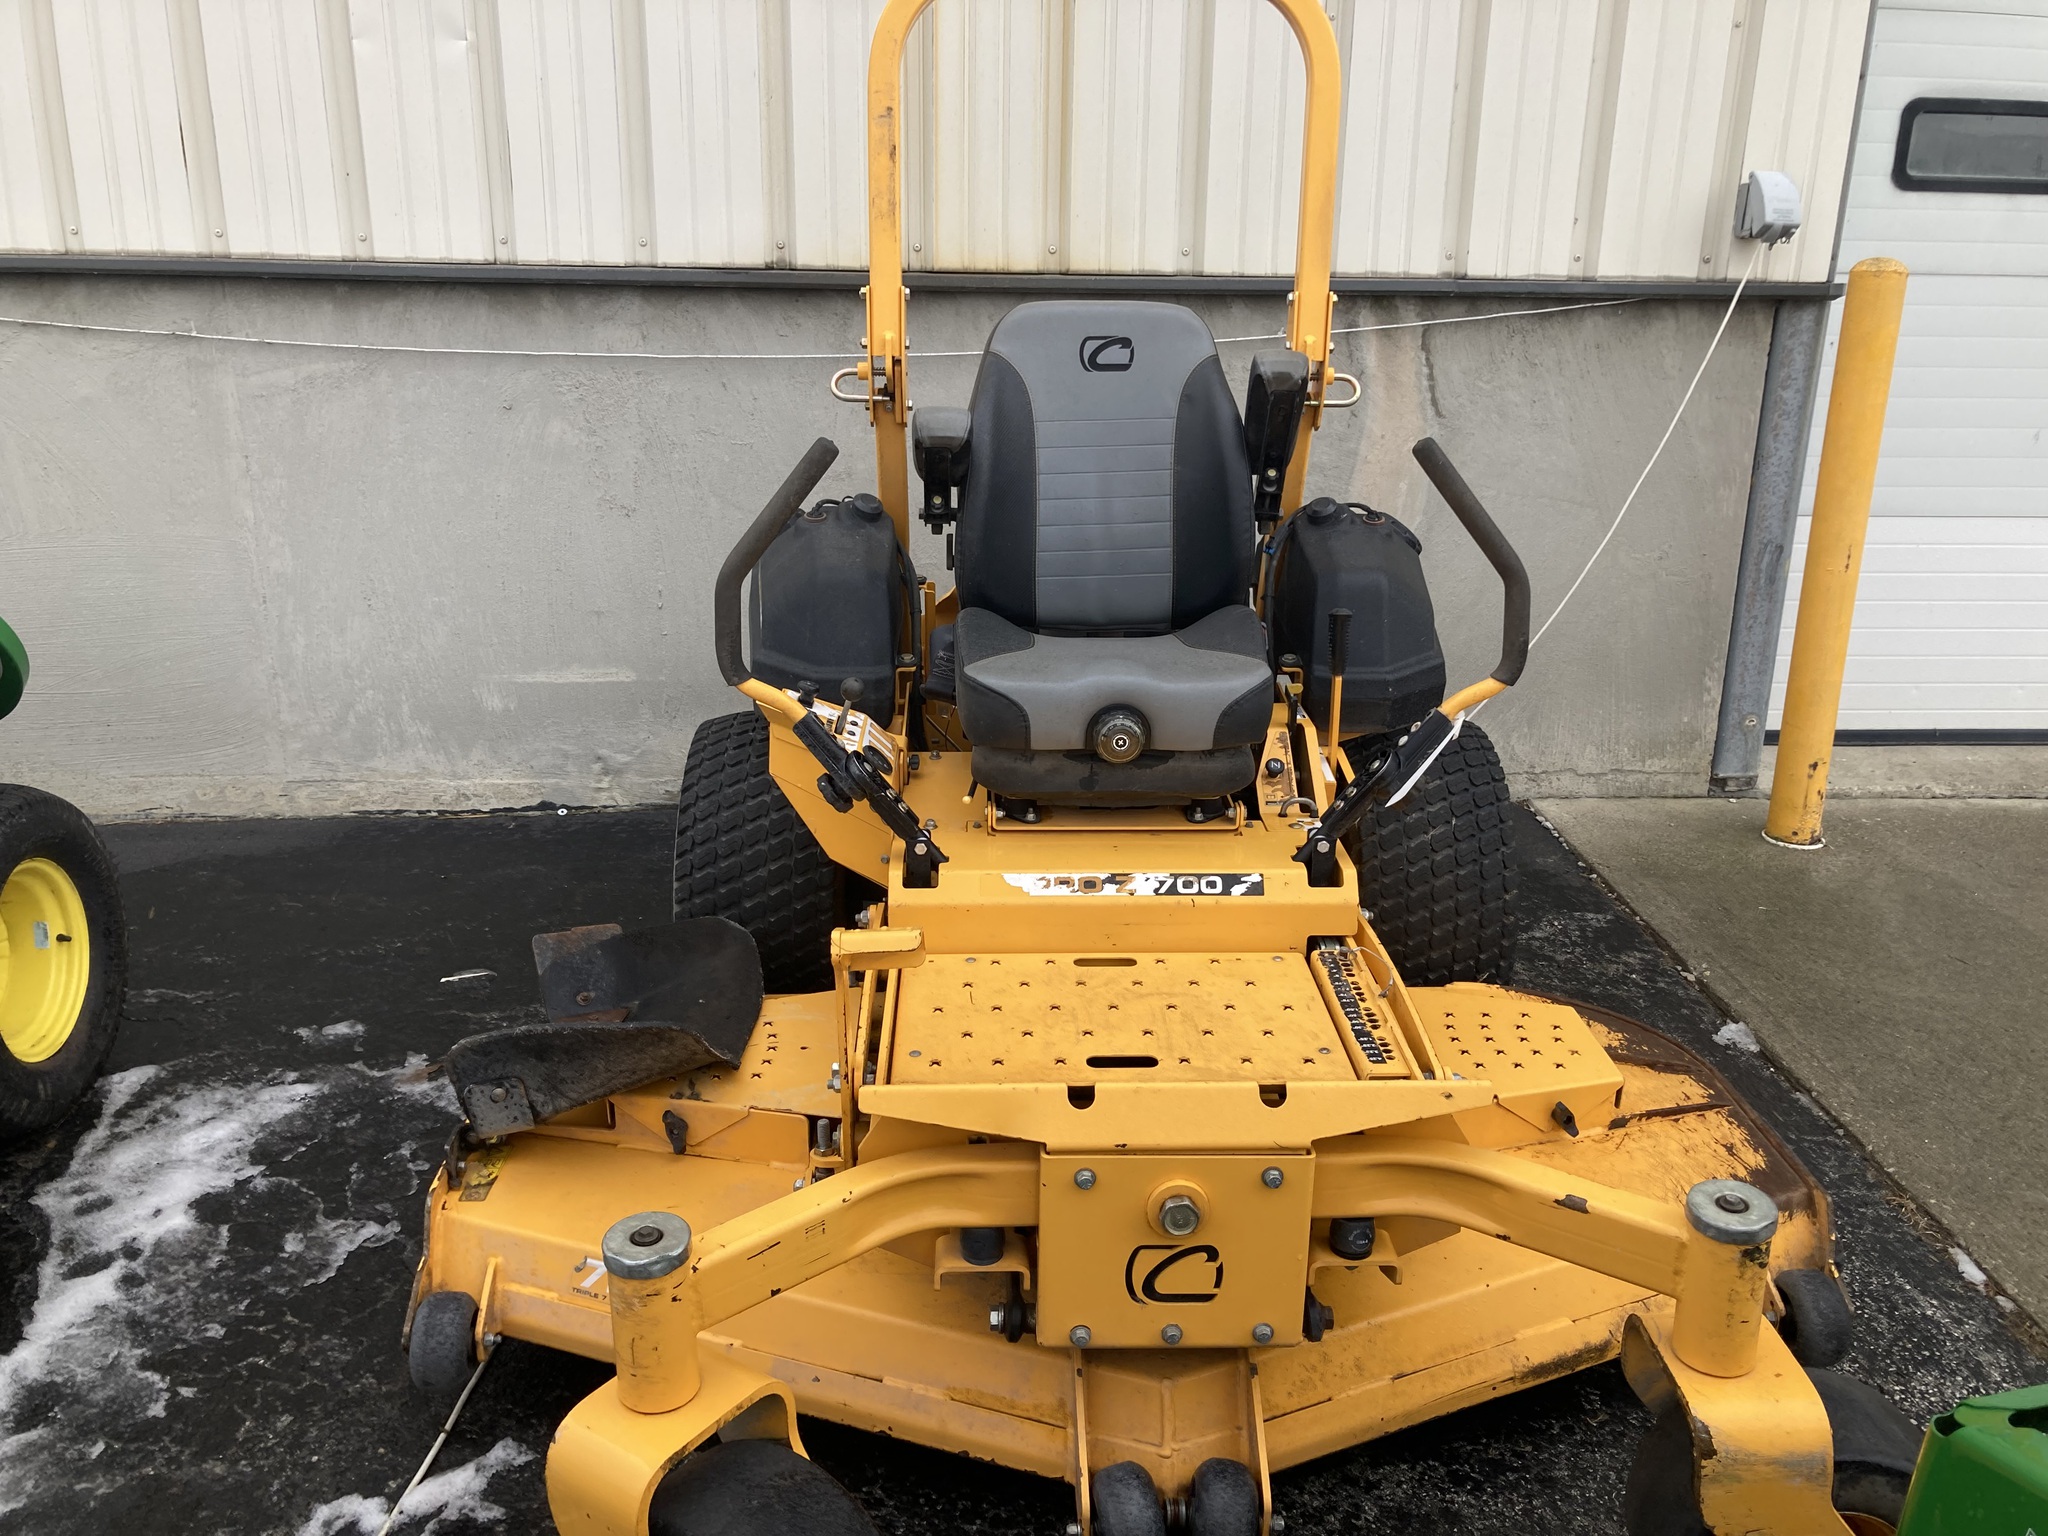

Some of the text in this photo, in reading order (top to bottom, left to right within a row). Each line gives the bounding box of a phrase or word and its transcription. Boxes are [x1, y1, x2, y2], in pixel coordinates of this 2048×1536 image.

[1115, 876, 1137, 894] Z
[1155, 875, 1223, 894] 700
[571, 1286, 599, 1299] TRIPLE
